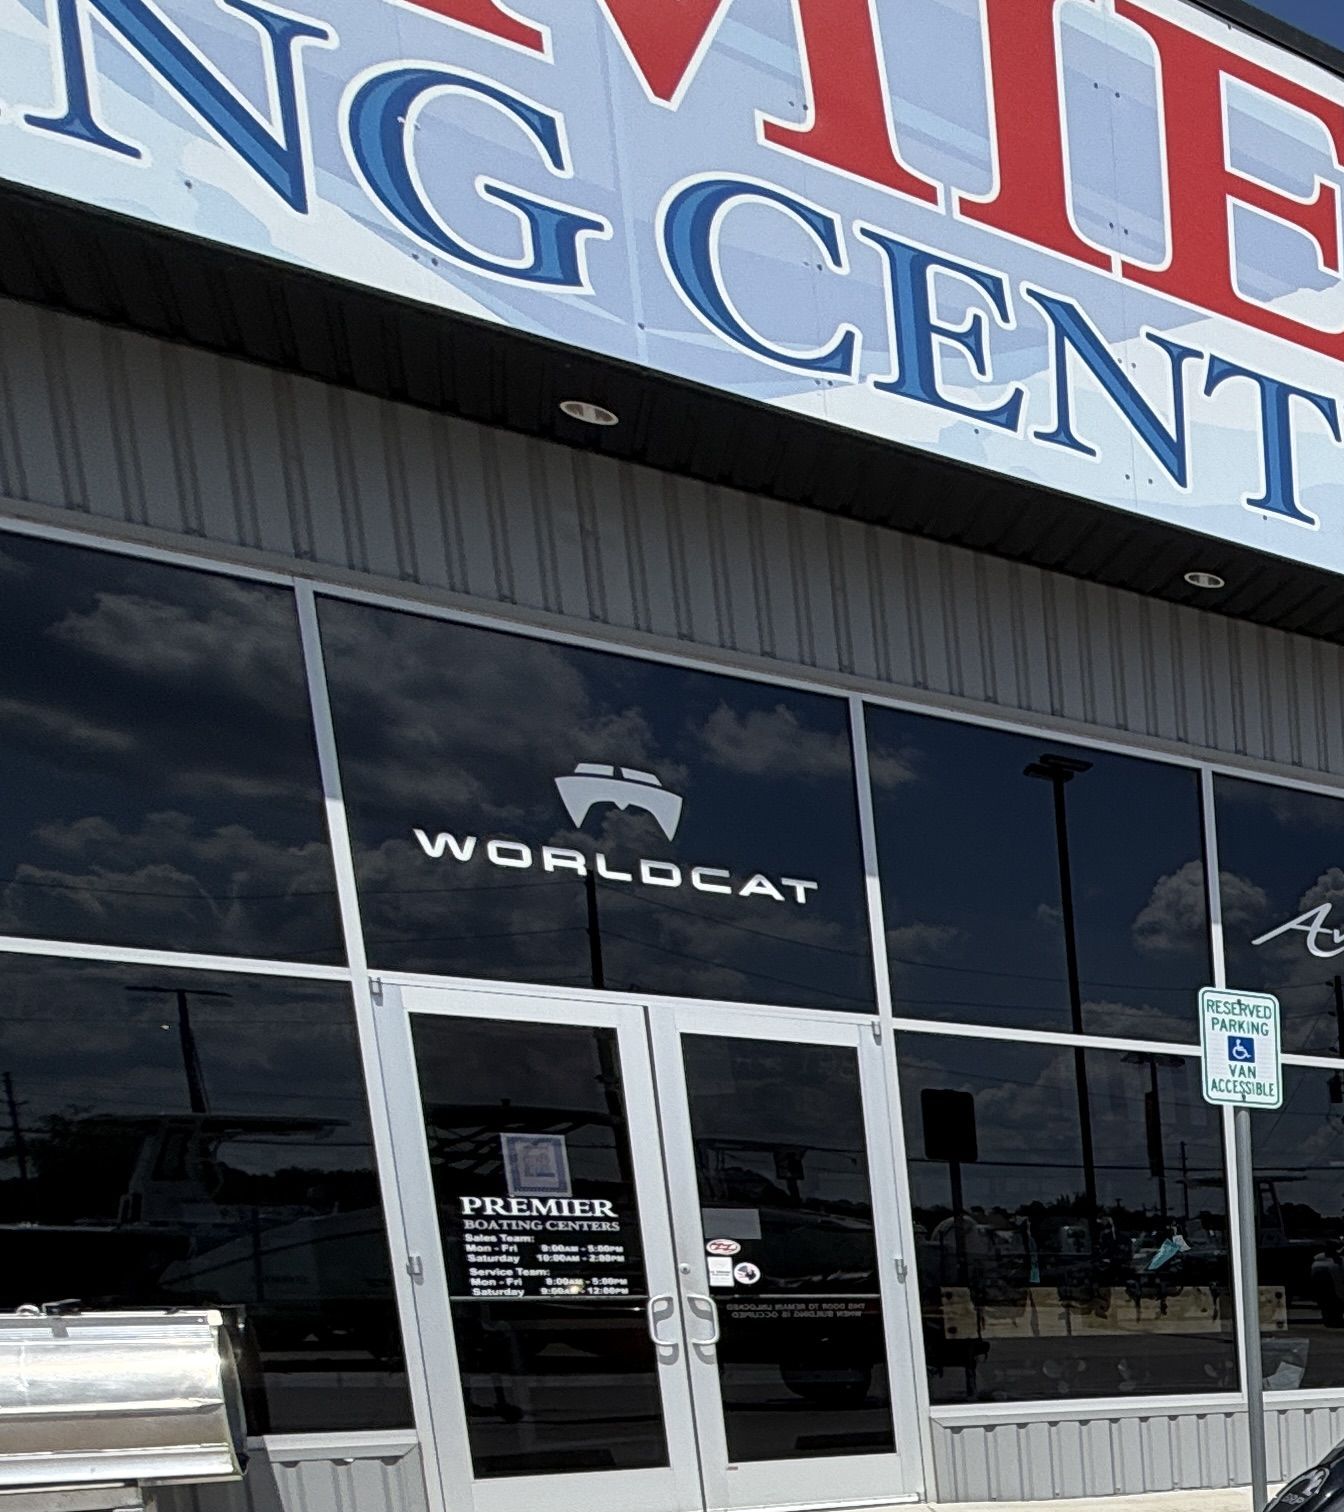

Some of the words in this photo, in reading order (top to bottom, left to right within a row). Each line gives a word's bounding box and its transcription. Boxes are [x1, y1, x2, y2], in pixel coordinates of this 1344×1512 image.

[412, 829, 818, 904] WORLDCAT
[1206, 999, 1273, 1020] RESERVED
[1211, 1017, 1270, 1037] PARKING
[1228, 1064, 1257, 1079] VAN
[1210, 1079, 1275, 1097] ACCESSIBLE
[459, 1196, 620, 1218] PREMIER
[463, 1219, 543, 1231] BOATING
[545, 1220, 621, 1231] CENTERS
[465, 1233, 498, 1243] Sales
[500, 1234, 535, 1243] Team:
[466, 1244, 493, 1253] Mon
[502, 1244, 519, 1253] Fri
[467, 1253, 521, 1264] Saturday
[469, 1267, 514, 1277] Service
[515, 1268, 551, 1277] Team:
[470, 1277, 498, 1286] Mon
[505, 1277, 523, 1286] Fri
[472, 1287, 525, 1298] Saturday
